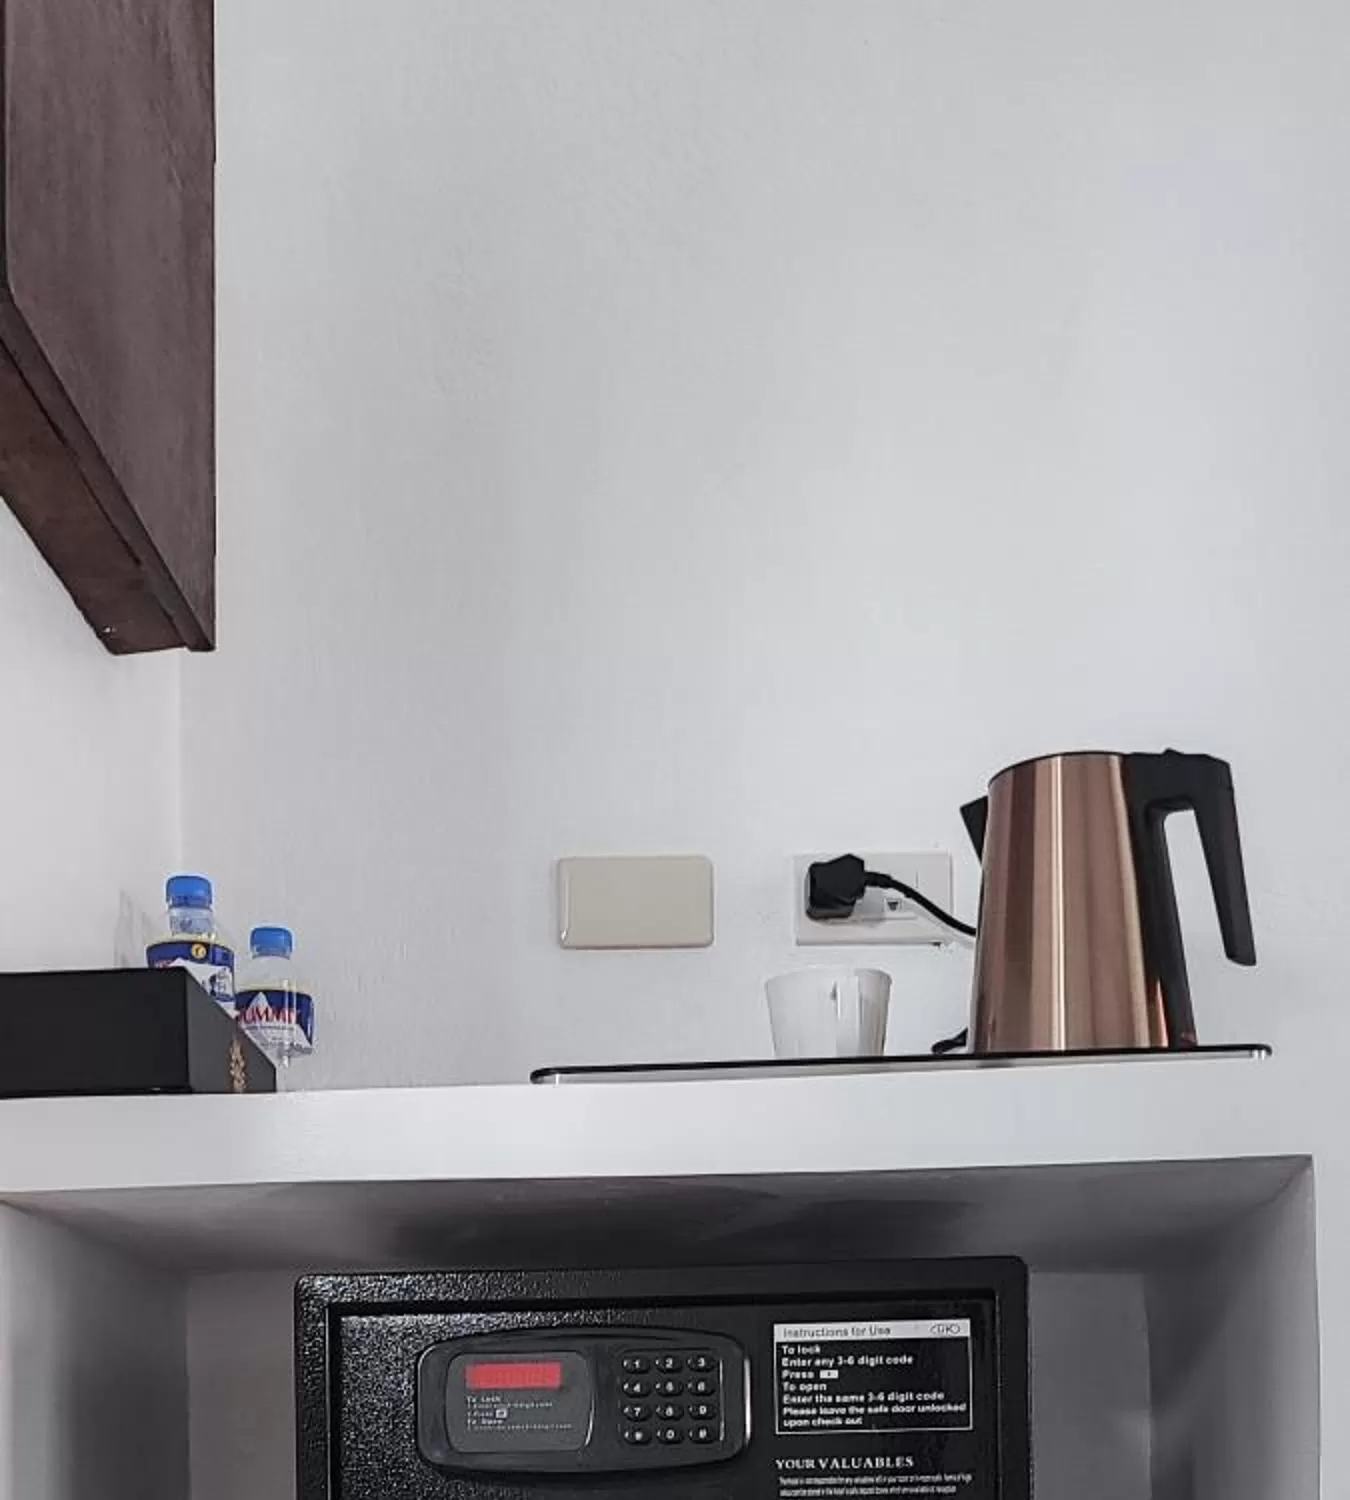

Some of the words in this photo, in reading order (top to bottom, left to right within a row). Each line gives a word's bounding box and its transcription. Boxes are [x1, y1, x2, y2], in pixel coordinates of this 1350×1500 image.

[783, 1327, 848, 1339] Instructions
[851, 1326, 867, 1337] for
[869, 1325, 892, 1337] Use
[781, 1344, 795, 1355] To
[797, 1344, 821, 1355] lock
[781, 1357, 812, 1368] Enter
[814, 1357, 835, 1369] any
[837, 1355, 855, 1366] 3-6
[857, 1355, 884, 1367] digit
[885, 1355, 914, 1365] code
[781, 1369, 815, 1379] Press
[782, 1382, 797, 1391] To
[799, 1383, 828, 1393] open
[783, 1394, 813, 1404] Enter
[815, 1393, 833, 1403] the
[835, 1394, 865, 1402] same
[867, 1392, 885, 1402] 3-6
[887, 1391, 914, 1404] digit
[916, 1391, 945, 1401] code
[782, 1406, 818, 1416] Please
[819, 1406, 847, 1416] leave
[848, 1405, 865, 1415] the
[867, 1404, 889, 1414] safe
[891, 1403, 916, 1413] door
[917, 1402, 967, 1413] unlocked
[783, 1418, 811, 1428] upon
[812, 1416, 843, 1426] check
[845, 1416, 864, 1426] out
[775, 1458, 816, 1470] YOUR
[818, 1455, 914, 1470] VALUABLES
